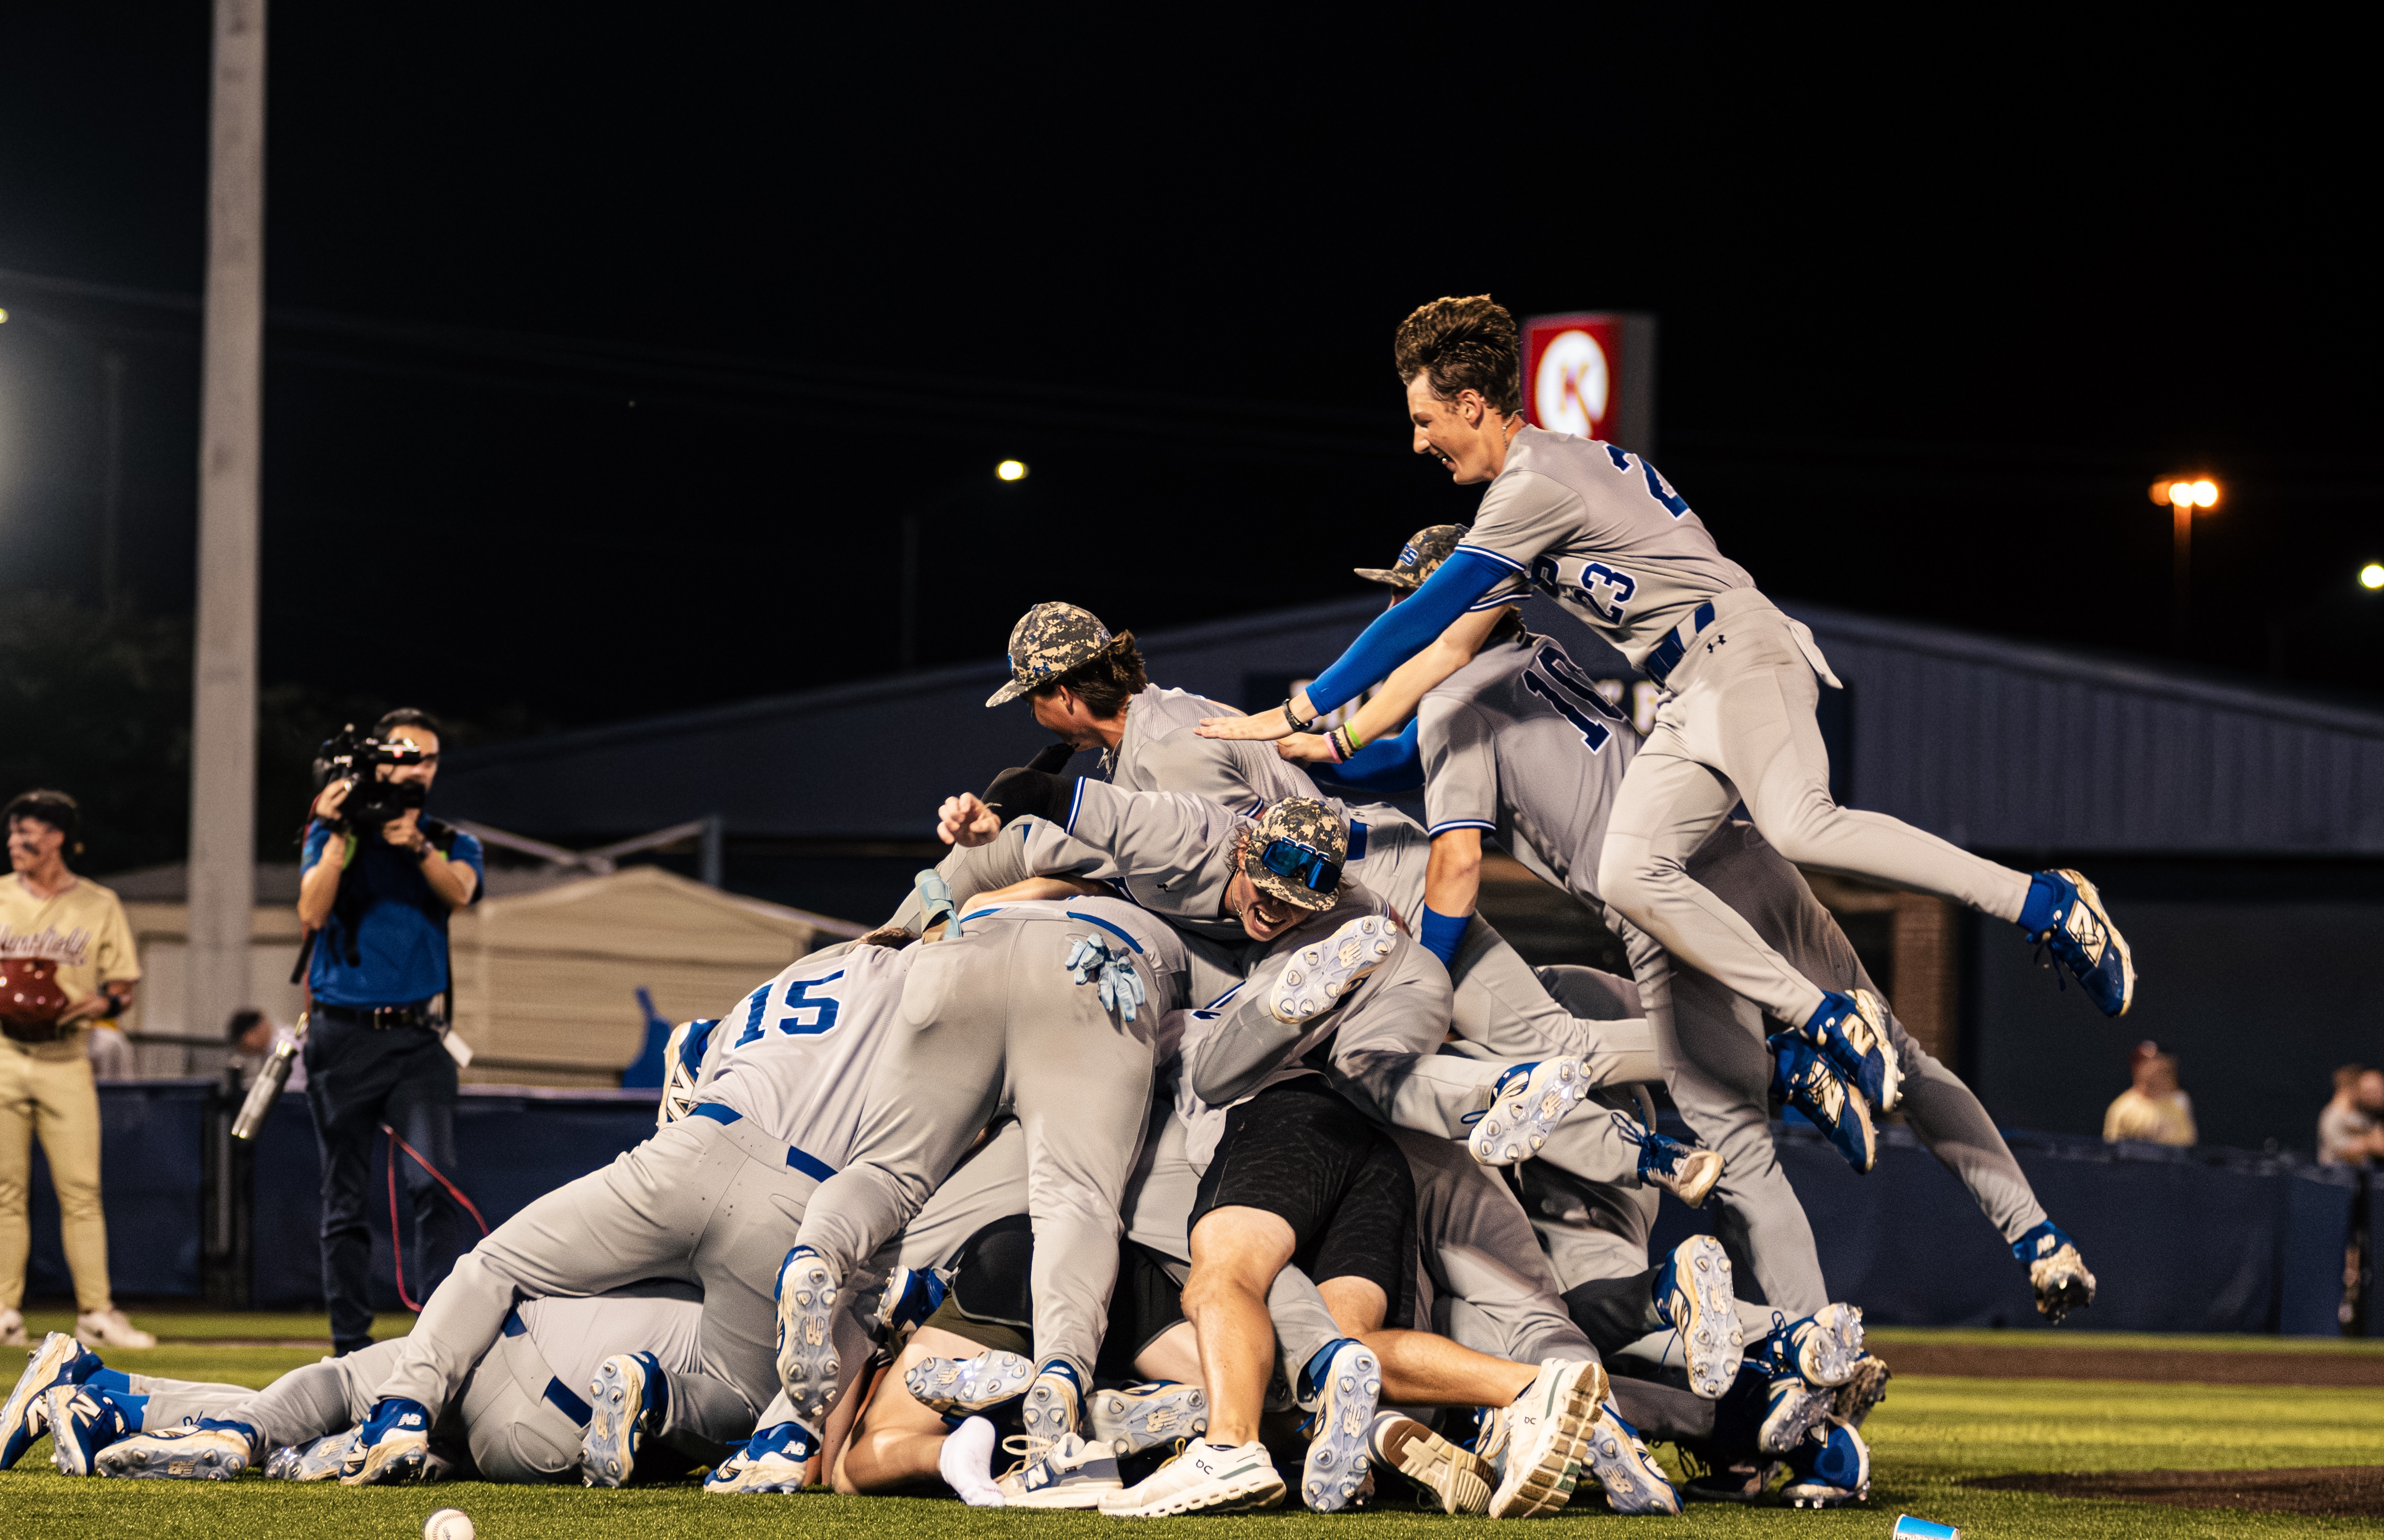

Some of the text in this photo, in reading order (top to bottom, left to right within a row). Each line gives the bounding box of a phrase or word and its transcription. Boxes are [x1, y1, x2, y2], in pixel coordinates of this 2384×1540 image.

[1573, 560, 1638, 626] 23
[1522, 645, 1630, 755] 10
[732, 967, 847, 1051] 15
[398, 1413, 421, 1426] NB
[781, 1440, 807, 1457] NB
[1027, 1463, 1049, 1490] N
